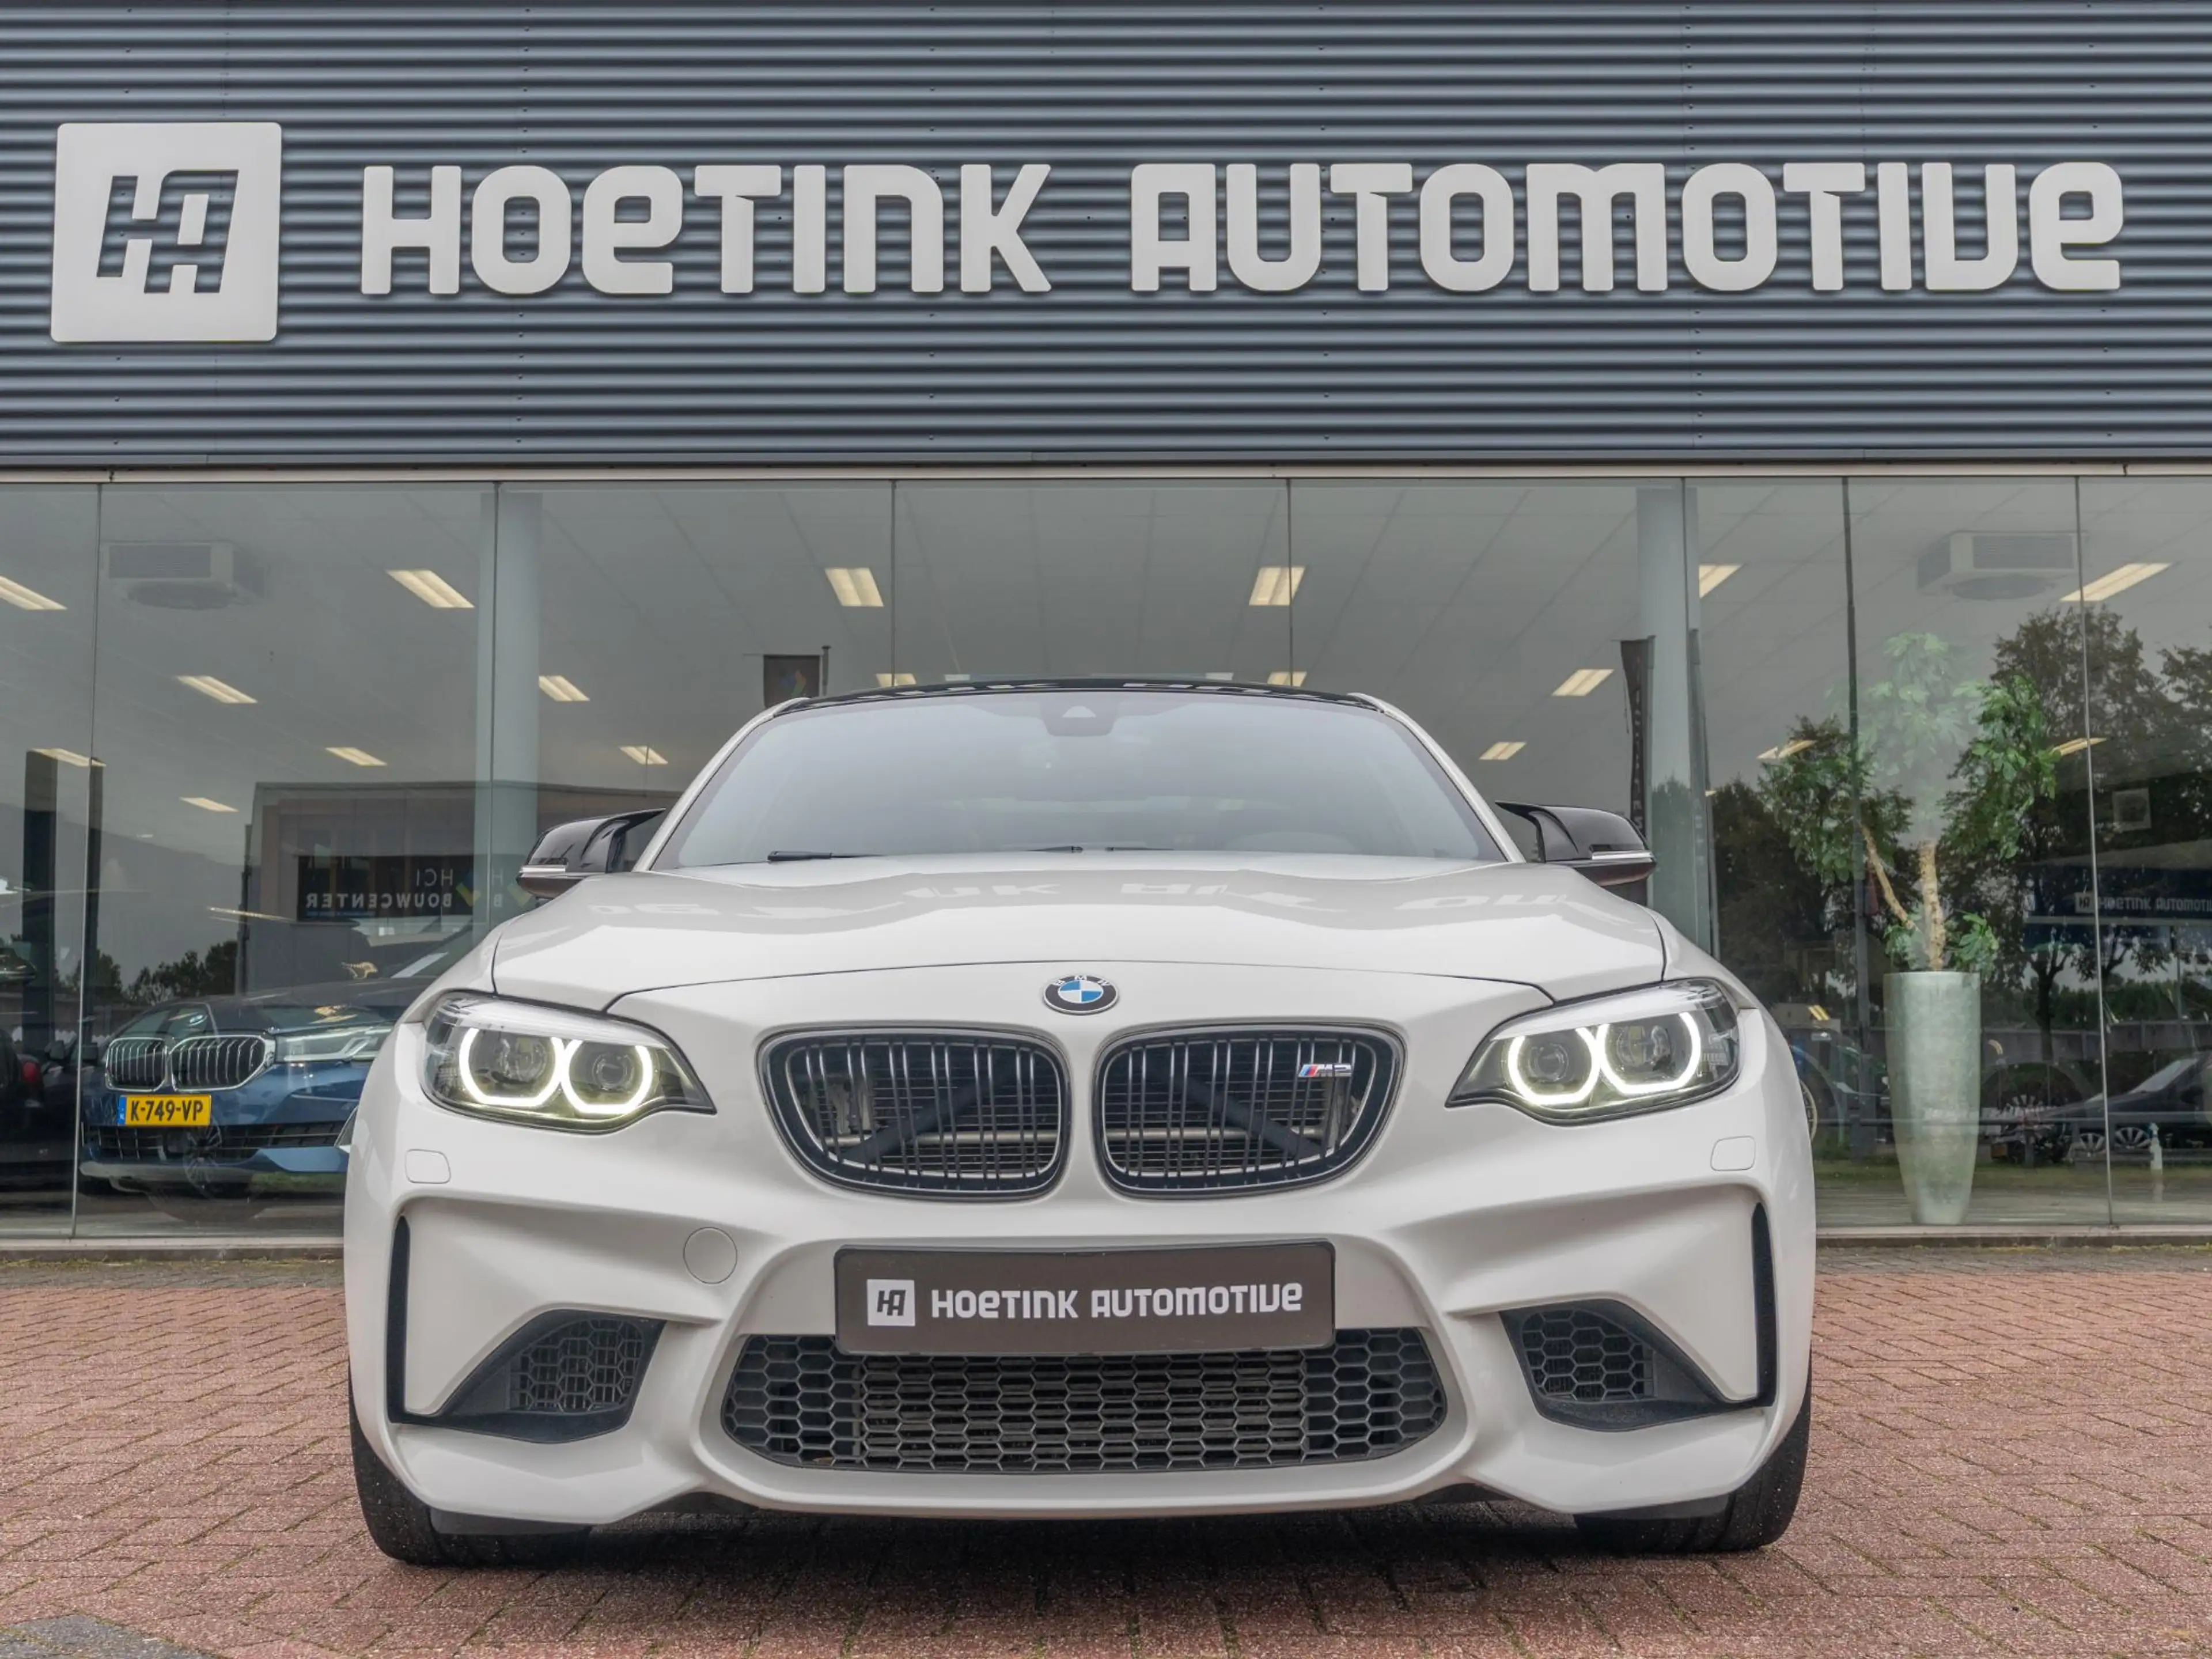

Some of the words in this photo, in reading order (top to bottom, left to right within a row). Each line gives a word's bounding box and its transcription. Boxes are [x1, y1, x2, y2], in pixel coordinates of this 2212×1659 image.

[362, 165, 1051, 294] HOETINK
[1131, 162, 2123, 291] AUTOMOTIVE
[2156, 897, 2212, 912] AUTOMOTI
[131, 1100, 203, 1121] K-749-VP
[931, 1290, 1078, 1319] HOETINK
[1091, 1282, 1302, 1318] AUTOMOTIVE
